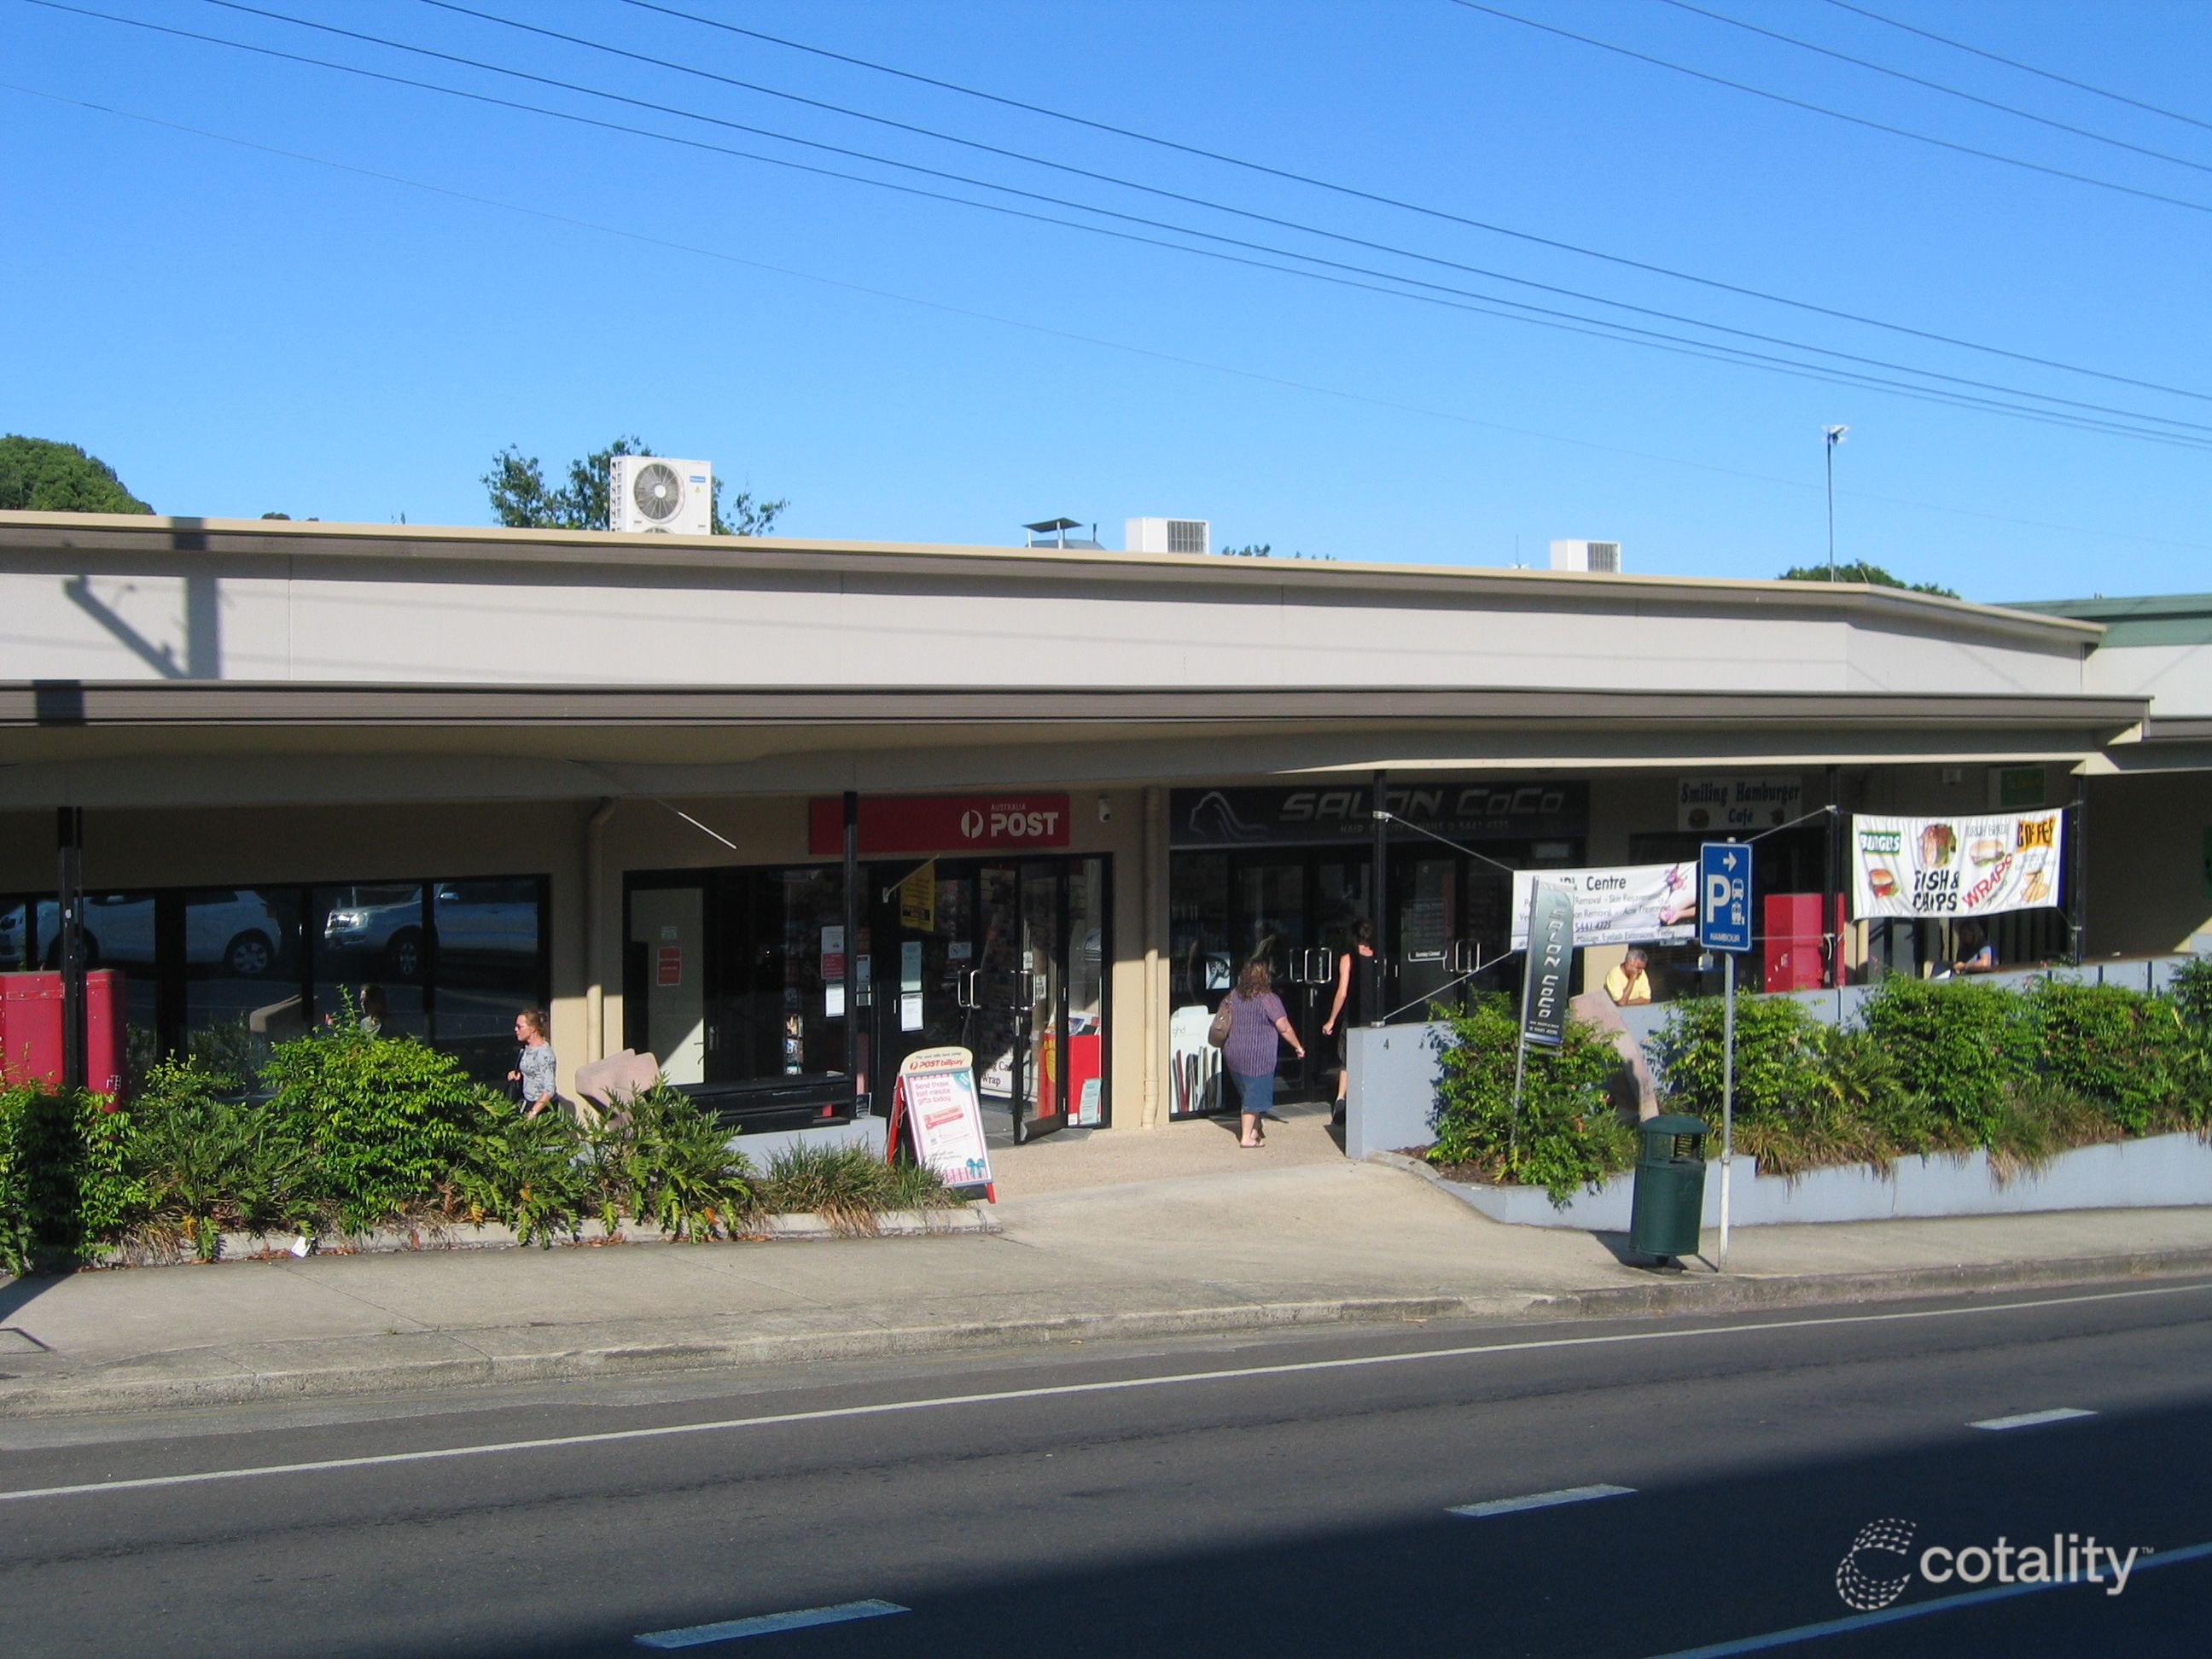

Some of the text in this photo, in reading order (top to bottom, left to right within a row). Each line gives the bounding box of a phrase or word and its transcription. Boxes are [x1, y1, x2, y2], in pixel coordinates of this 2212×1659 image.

[1278, 790, 1444, 820] SALON
[1681, 782, 1800, 806] Smiling Hamburger
[991, 803, 1026, 812] AUSTRALIA
[991, 812, 1058, 837] POST
[1586, 876, 1626, 891] Centre
[1914, 869, 1959, 891] FISH &
[1963, 853, 2013, 908] WRAPS
[1707, 874, 1731, 923] P
[1912, 892, 1957, 911] CHIPS
[1544, 910, 1564, 968] SALON
[1710, 932, 1740, 942] NAMBOUR
[1173, 1026, 1186, 1038] ghd
[919, 1057, 965, 1068] POST billpay
